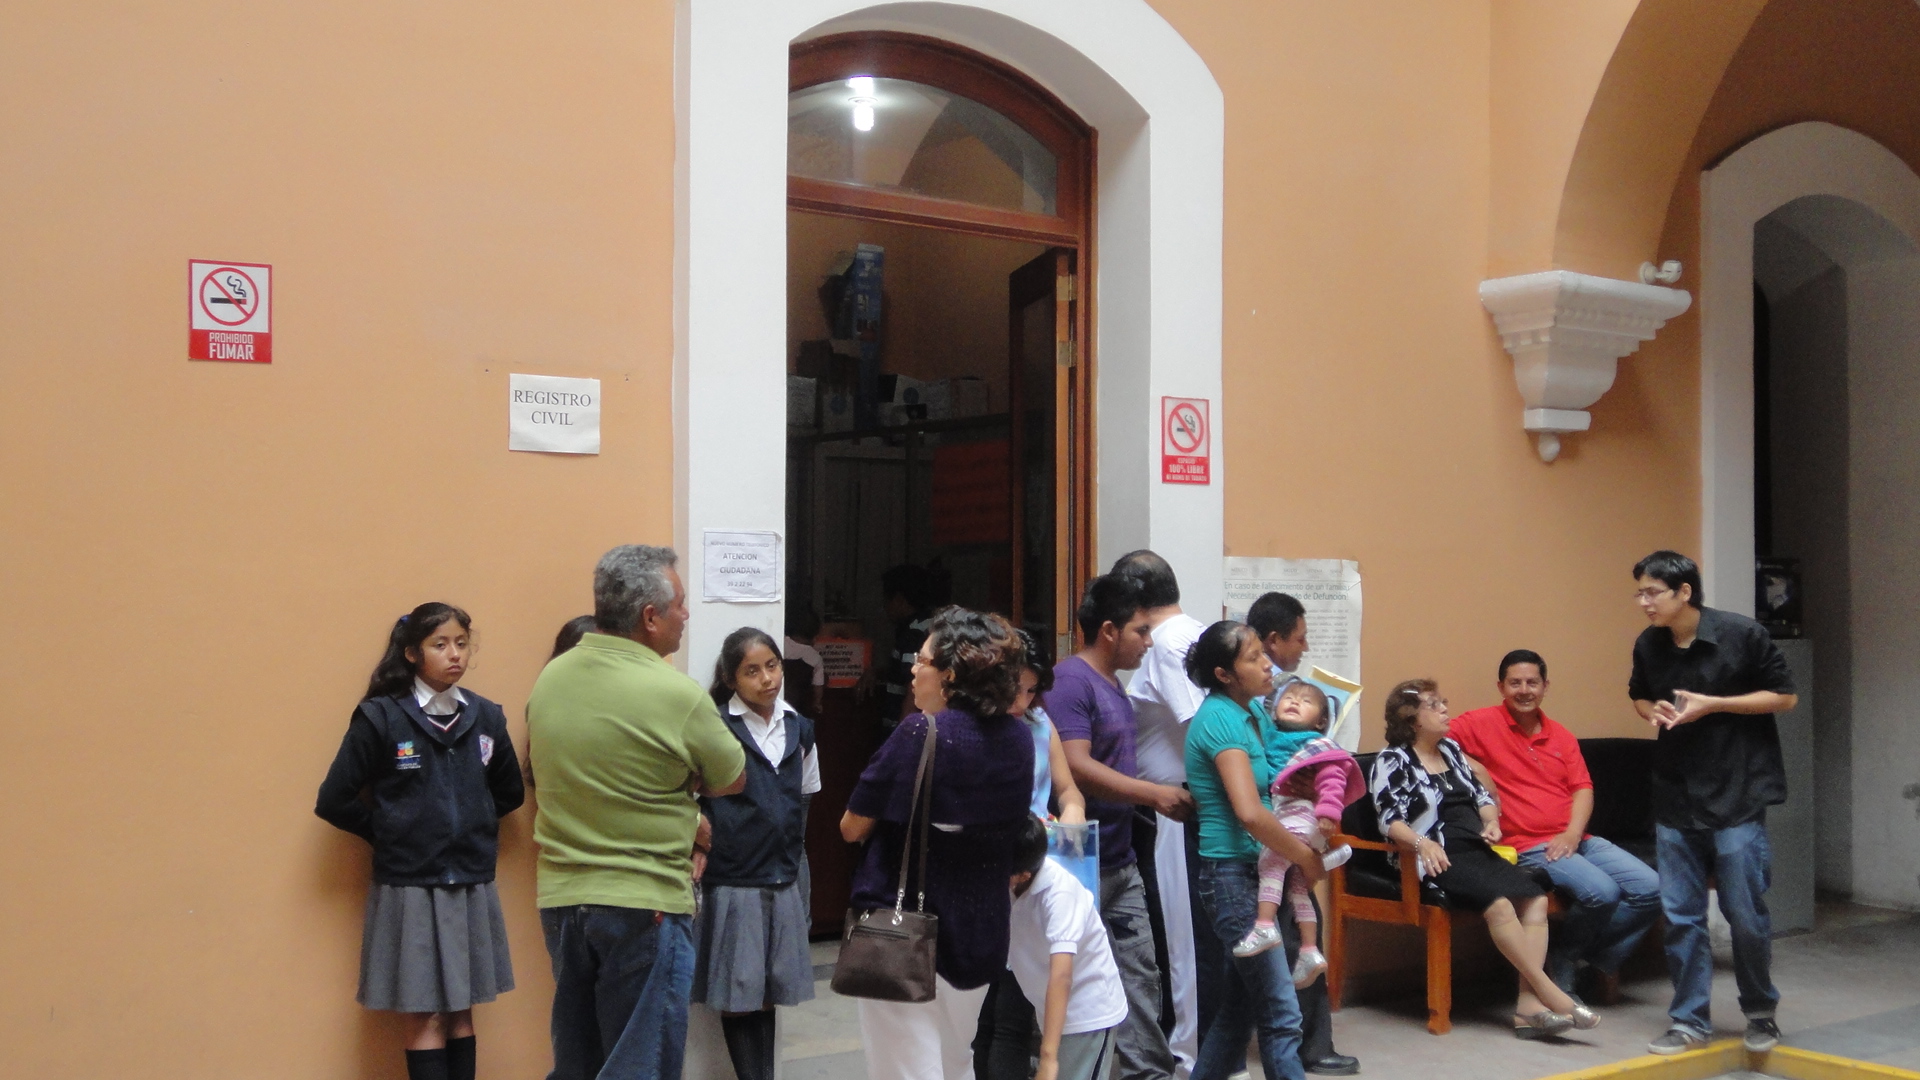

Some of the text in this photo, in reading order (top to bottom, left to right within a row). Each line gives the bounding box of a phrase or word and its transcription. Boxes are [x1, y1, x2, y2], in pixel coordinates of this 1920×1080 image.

[209, 332, 254, 344] PROHIBIDO
[209, 343, 254, 360] FUMAR
[513, 389, 592, 407] REGISTRO
[531, 410, 574, 426] CIVIL
[1169, 463, 1205, 474] 100% LIBRE
[722, 552, 758, 561] ATENCION
[719, 566, 761, 575] CIUDADANA
[1224, 581, 1233, 590] En
[1252, 582, 1261, 590] de
[1261, 581, 1304, 591] fallecimiento
[1305, 583, 1315, 591] de
[1303, 592, 1312, 600] de
